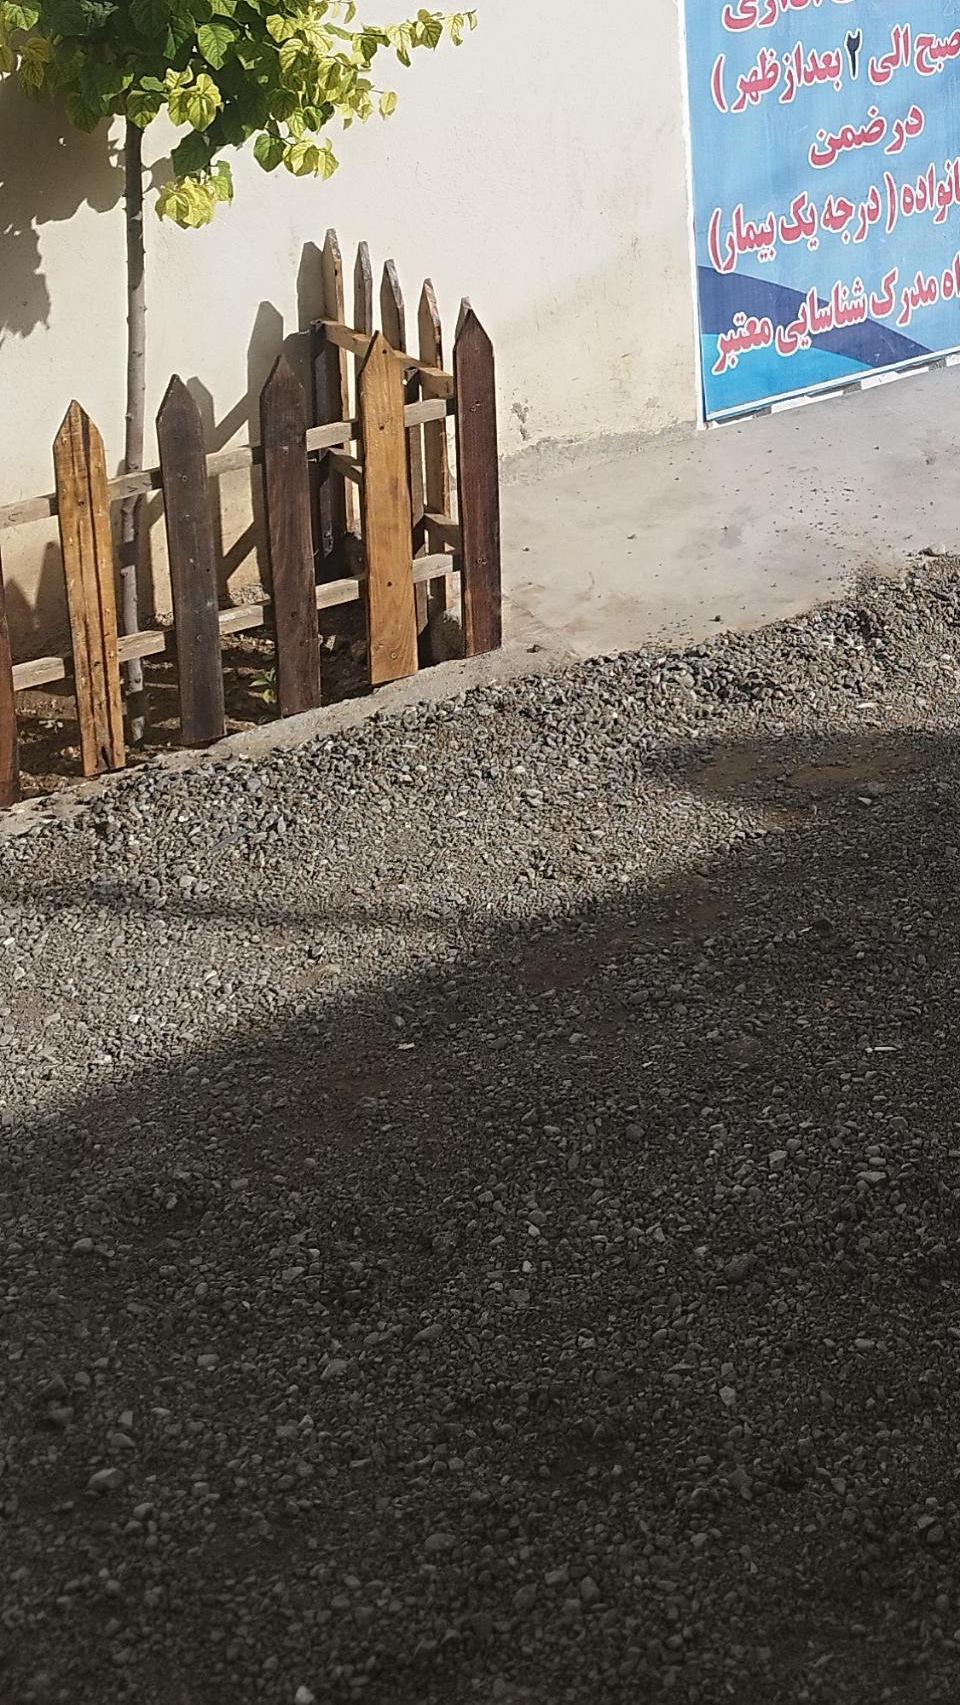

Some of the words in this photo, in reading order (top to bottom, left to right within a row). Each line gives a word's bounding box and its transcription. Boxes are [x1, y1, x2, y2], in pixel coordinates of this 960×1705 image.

[845, 28, 862, 78] ۲
[868, 23, 911, 84] الی
[778, 191, 818, 249] یک
[775, 277, 868, 357] شناسایی
[870, 267, 939, 327] مدرک
[712, 312, 773, 376] معتبر
